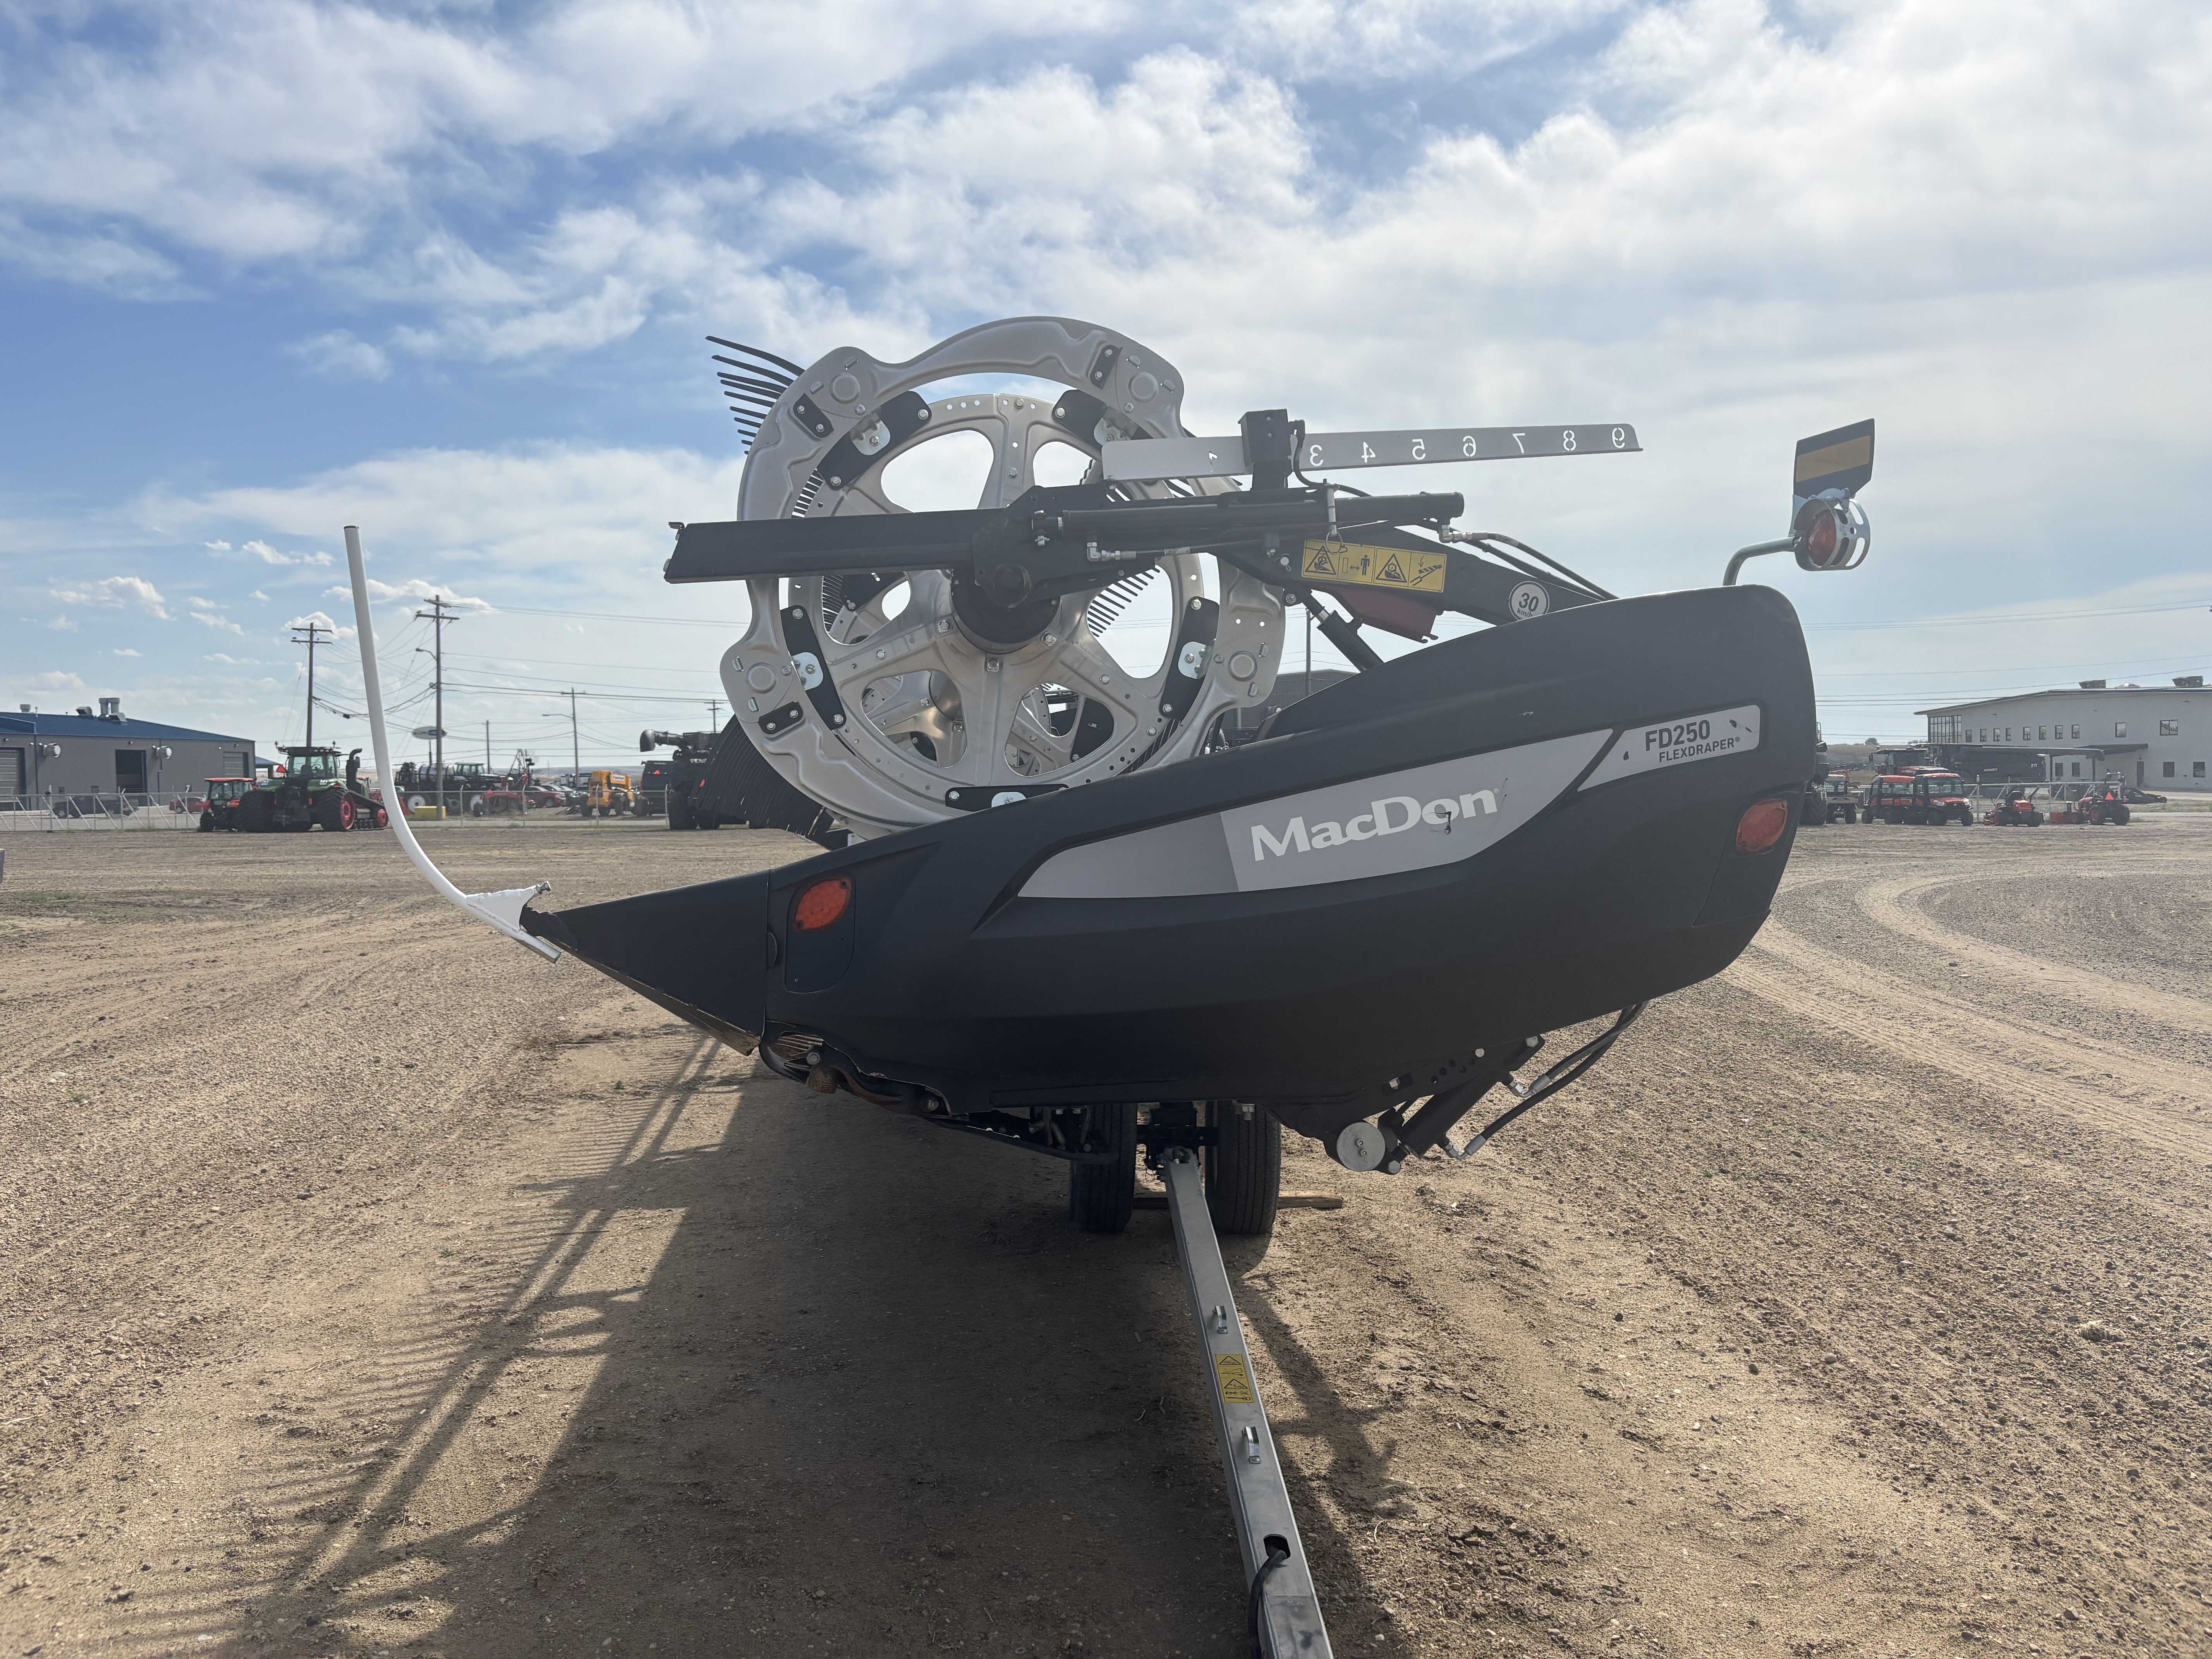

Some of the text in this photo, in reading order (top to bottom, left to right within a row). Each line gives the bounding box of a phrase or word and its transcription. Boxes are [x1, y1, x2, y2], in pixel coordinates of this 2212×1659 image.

[1518, 592, 1539, 612] 30
[1517, 608, 1533, 618] km/h
[1645, 720, 1710, 751] FD250
